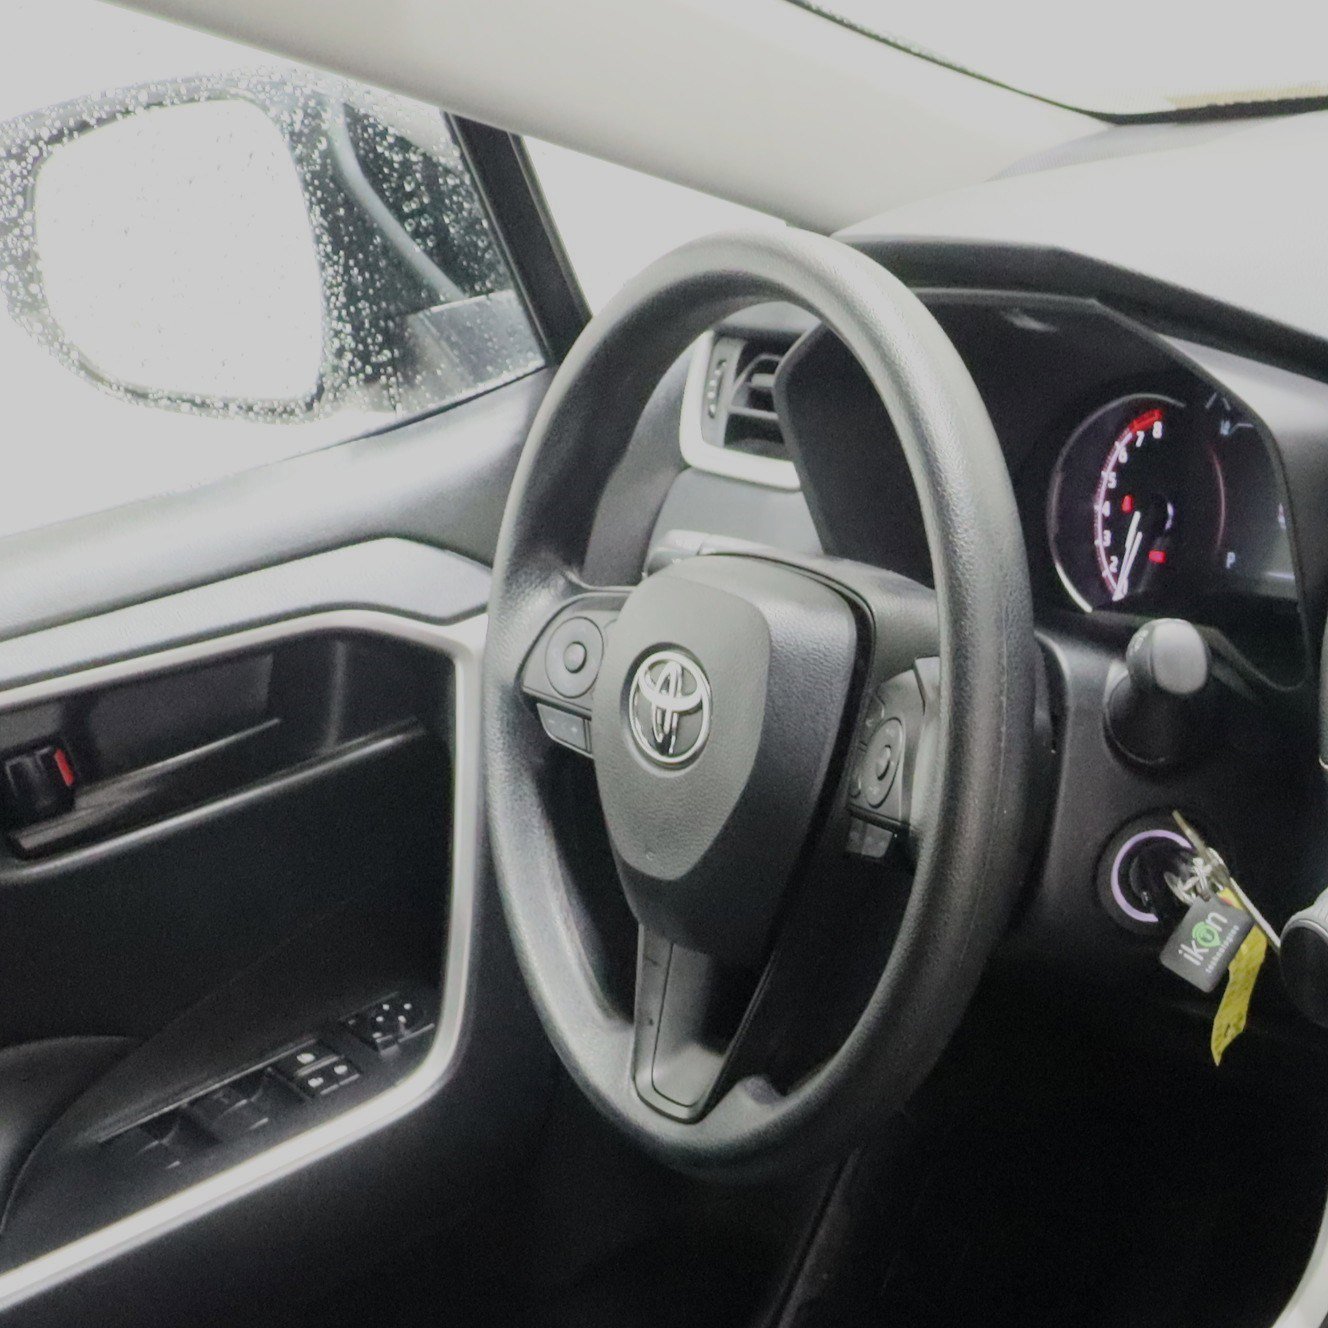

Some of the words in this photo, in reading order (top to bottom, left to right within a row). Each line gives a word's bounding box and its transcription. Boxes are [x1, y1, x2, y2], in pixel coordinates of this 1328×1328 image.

[1136, 430, 1145, 447] 7
[1107, 471, 1117, 489] 5
[1103, 530, 1111, 547] 3
[1109, 555, 1118, 573] 2
